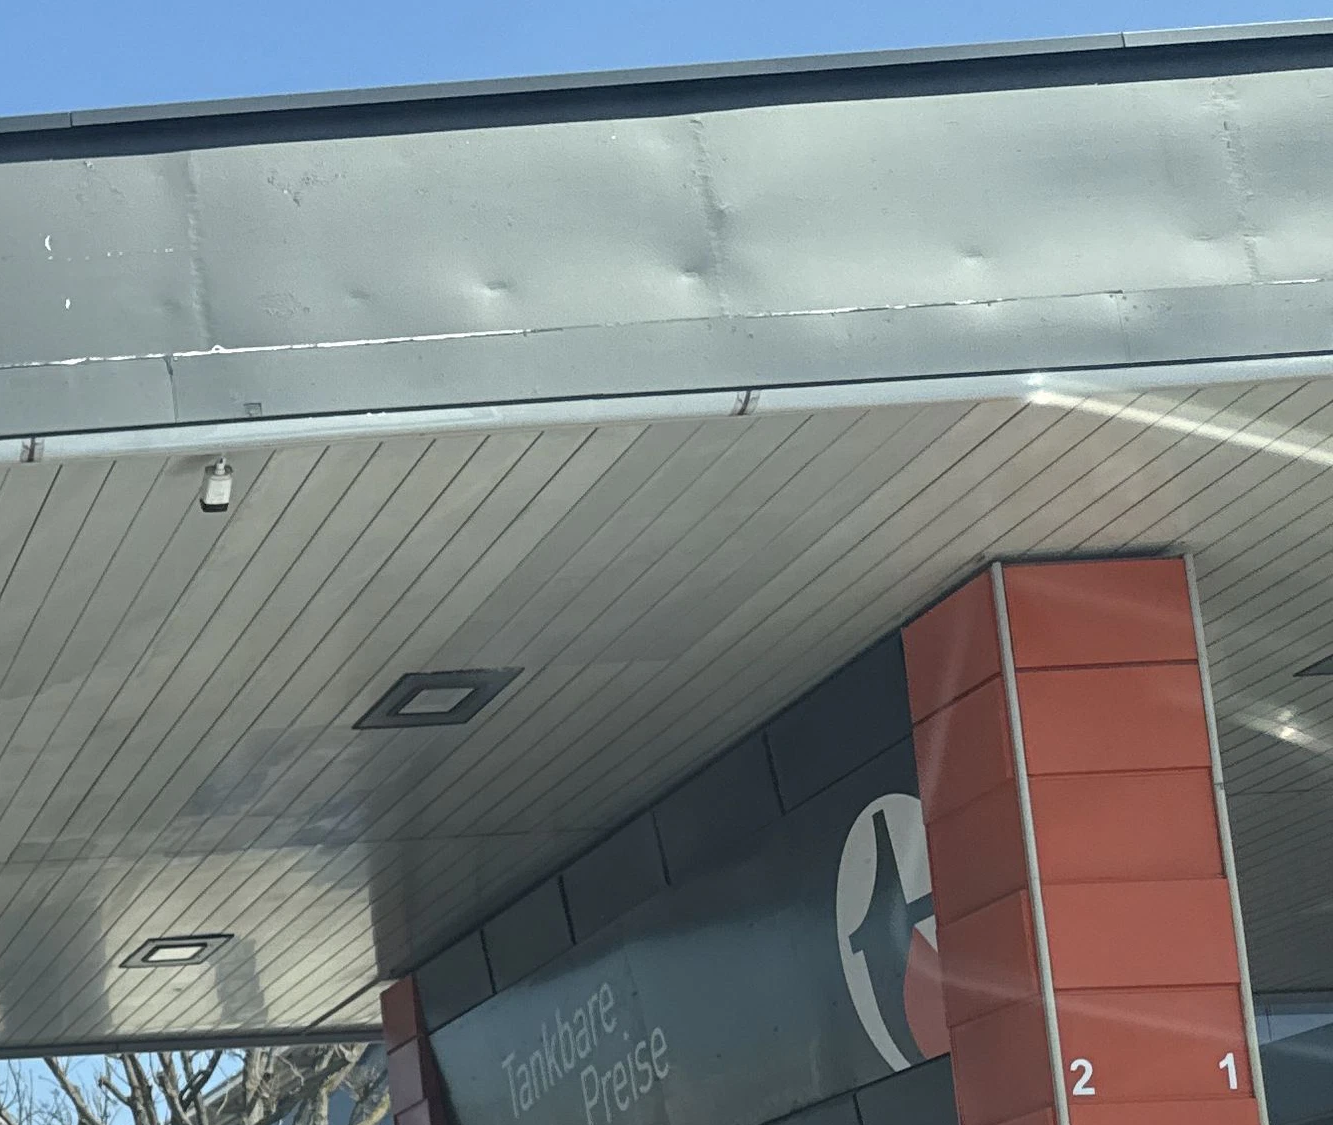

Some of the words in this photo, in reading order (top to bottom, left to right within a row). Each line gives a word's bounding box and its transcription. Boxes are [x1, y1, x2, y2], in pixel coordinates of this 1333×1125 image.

[501, 982, 618, 1120] Tankbare
[1069, 1058, 1096, 1096] 2
[1219, 1052, 1238, 1090] 1
